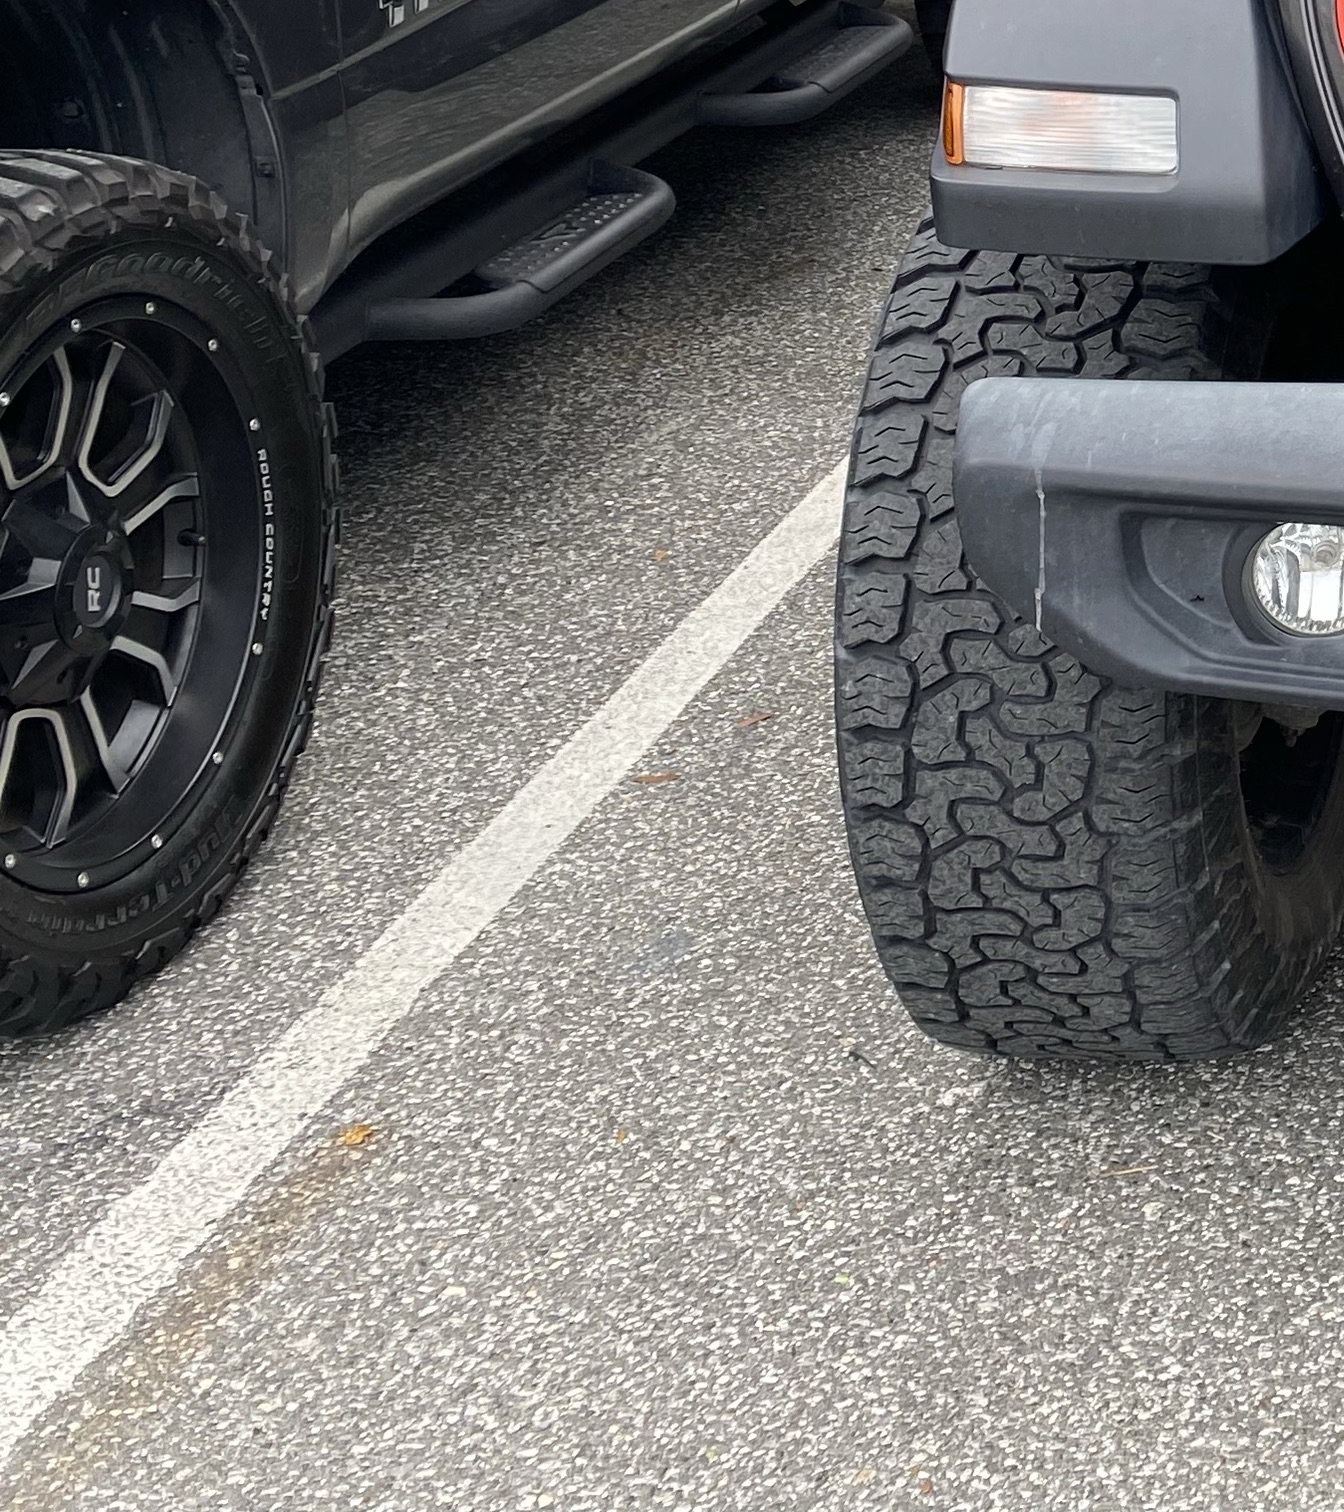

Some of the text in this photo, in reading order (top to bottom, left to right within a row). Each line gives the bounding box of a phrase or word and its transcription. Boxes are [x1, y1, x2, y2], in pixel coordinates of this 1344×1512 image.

[257, 448, 275, 621] ROUGH COUNTRY
[87, 567, 100, 611] RC
